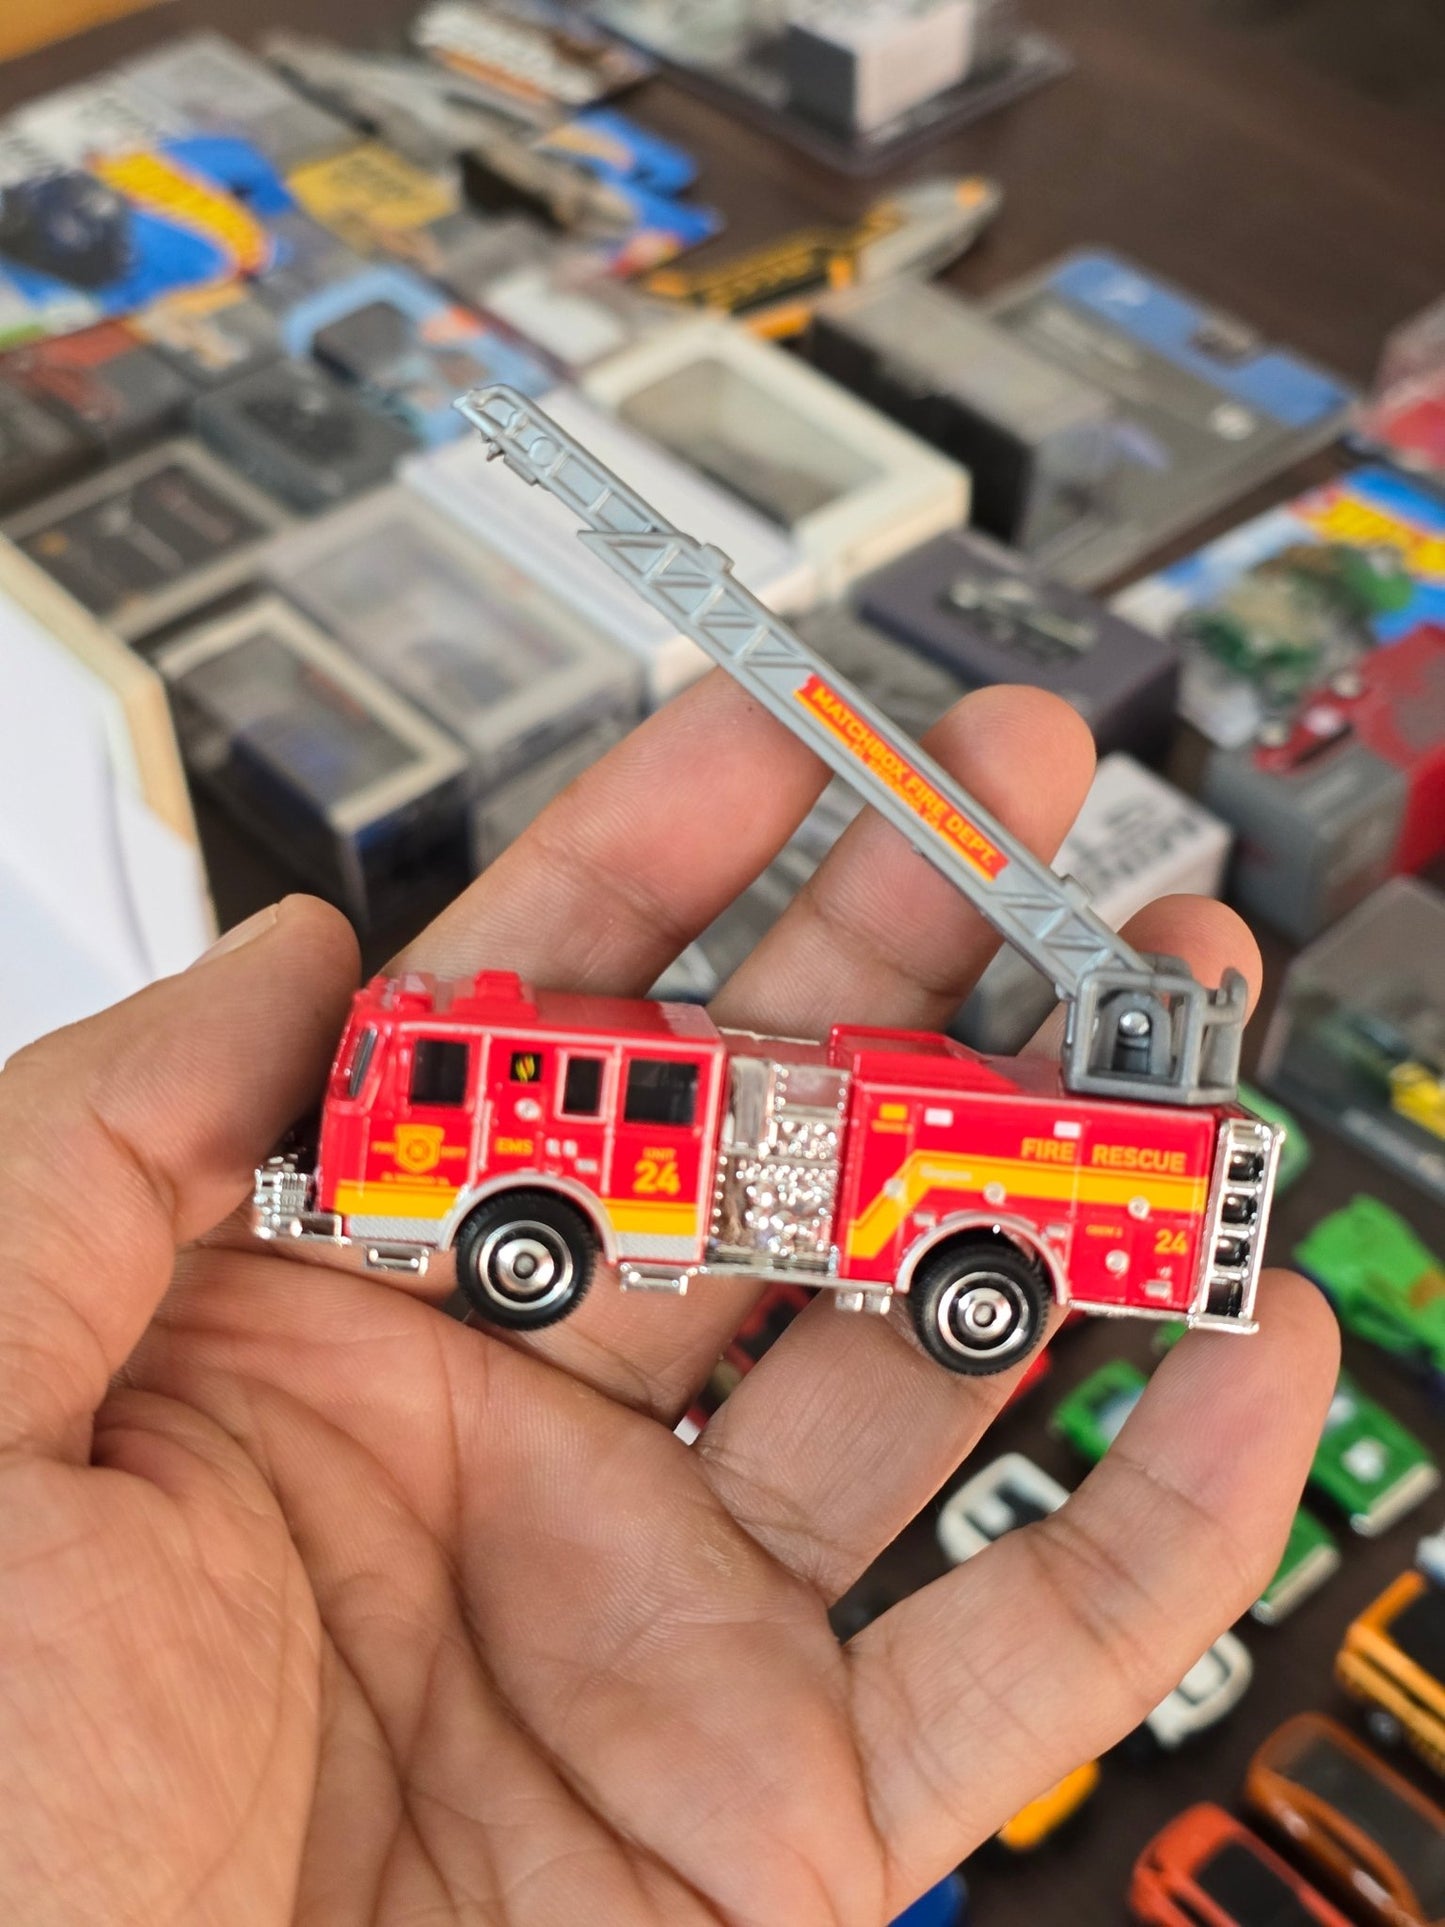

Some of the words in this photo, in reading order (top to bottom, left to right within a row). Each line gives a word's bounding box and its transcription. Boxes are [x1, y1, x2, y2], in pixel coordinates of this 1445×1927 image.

[813, 689, 906, 780] MATCHBOX
[906, 778, 947, 816] FIRE
[496, 1138, 533, 1155] EMS
[1022, 1138, 1076, 1162] FIRE
[1092, 1144, 1186, 1173] RESCUE
[634, 1161, 680, 1194] 24
[1155, 1229, 1188, 1255] 24
